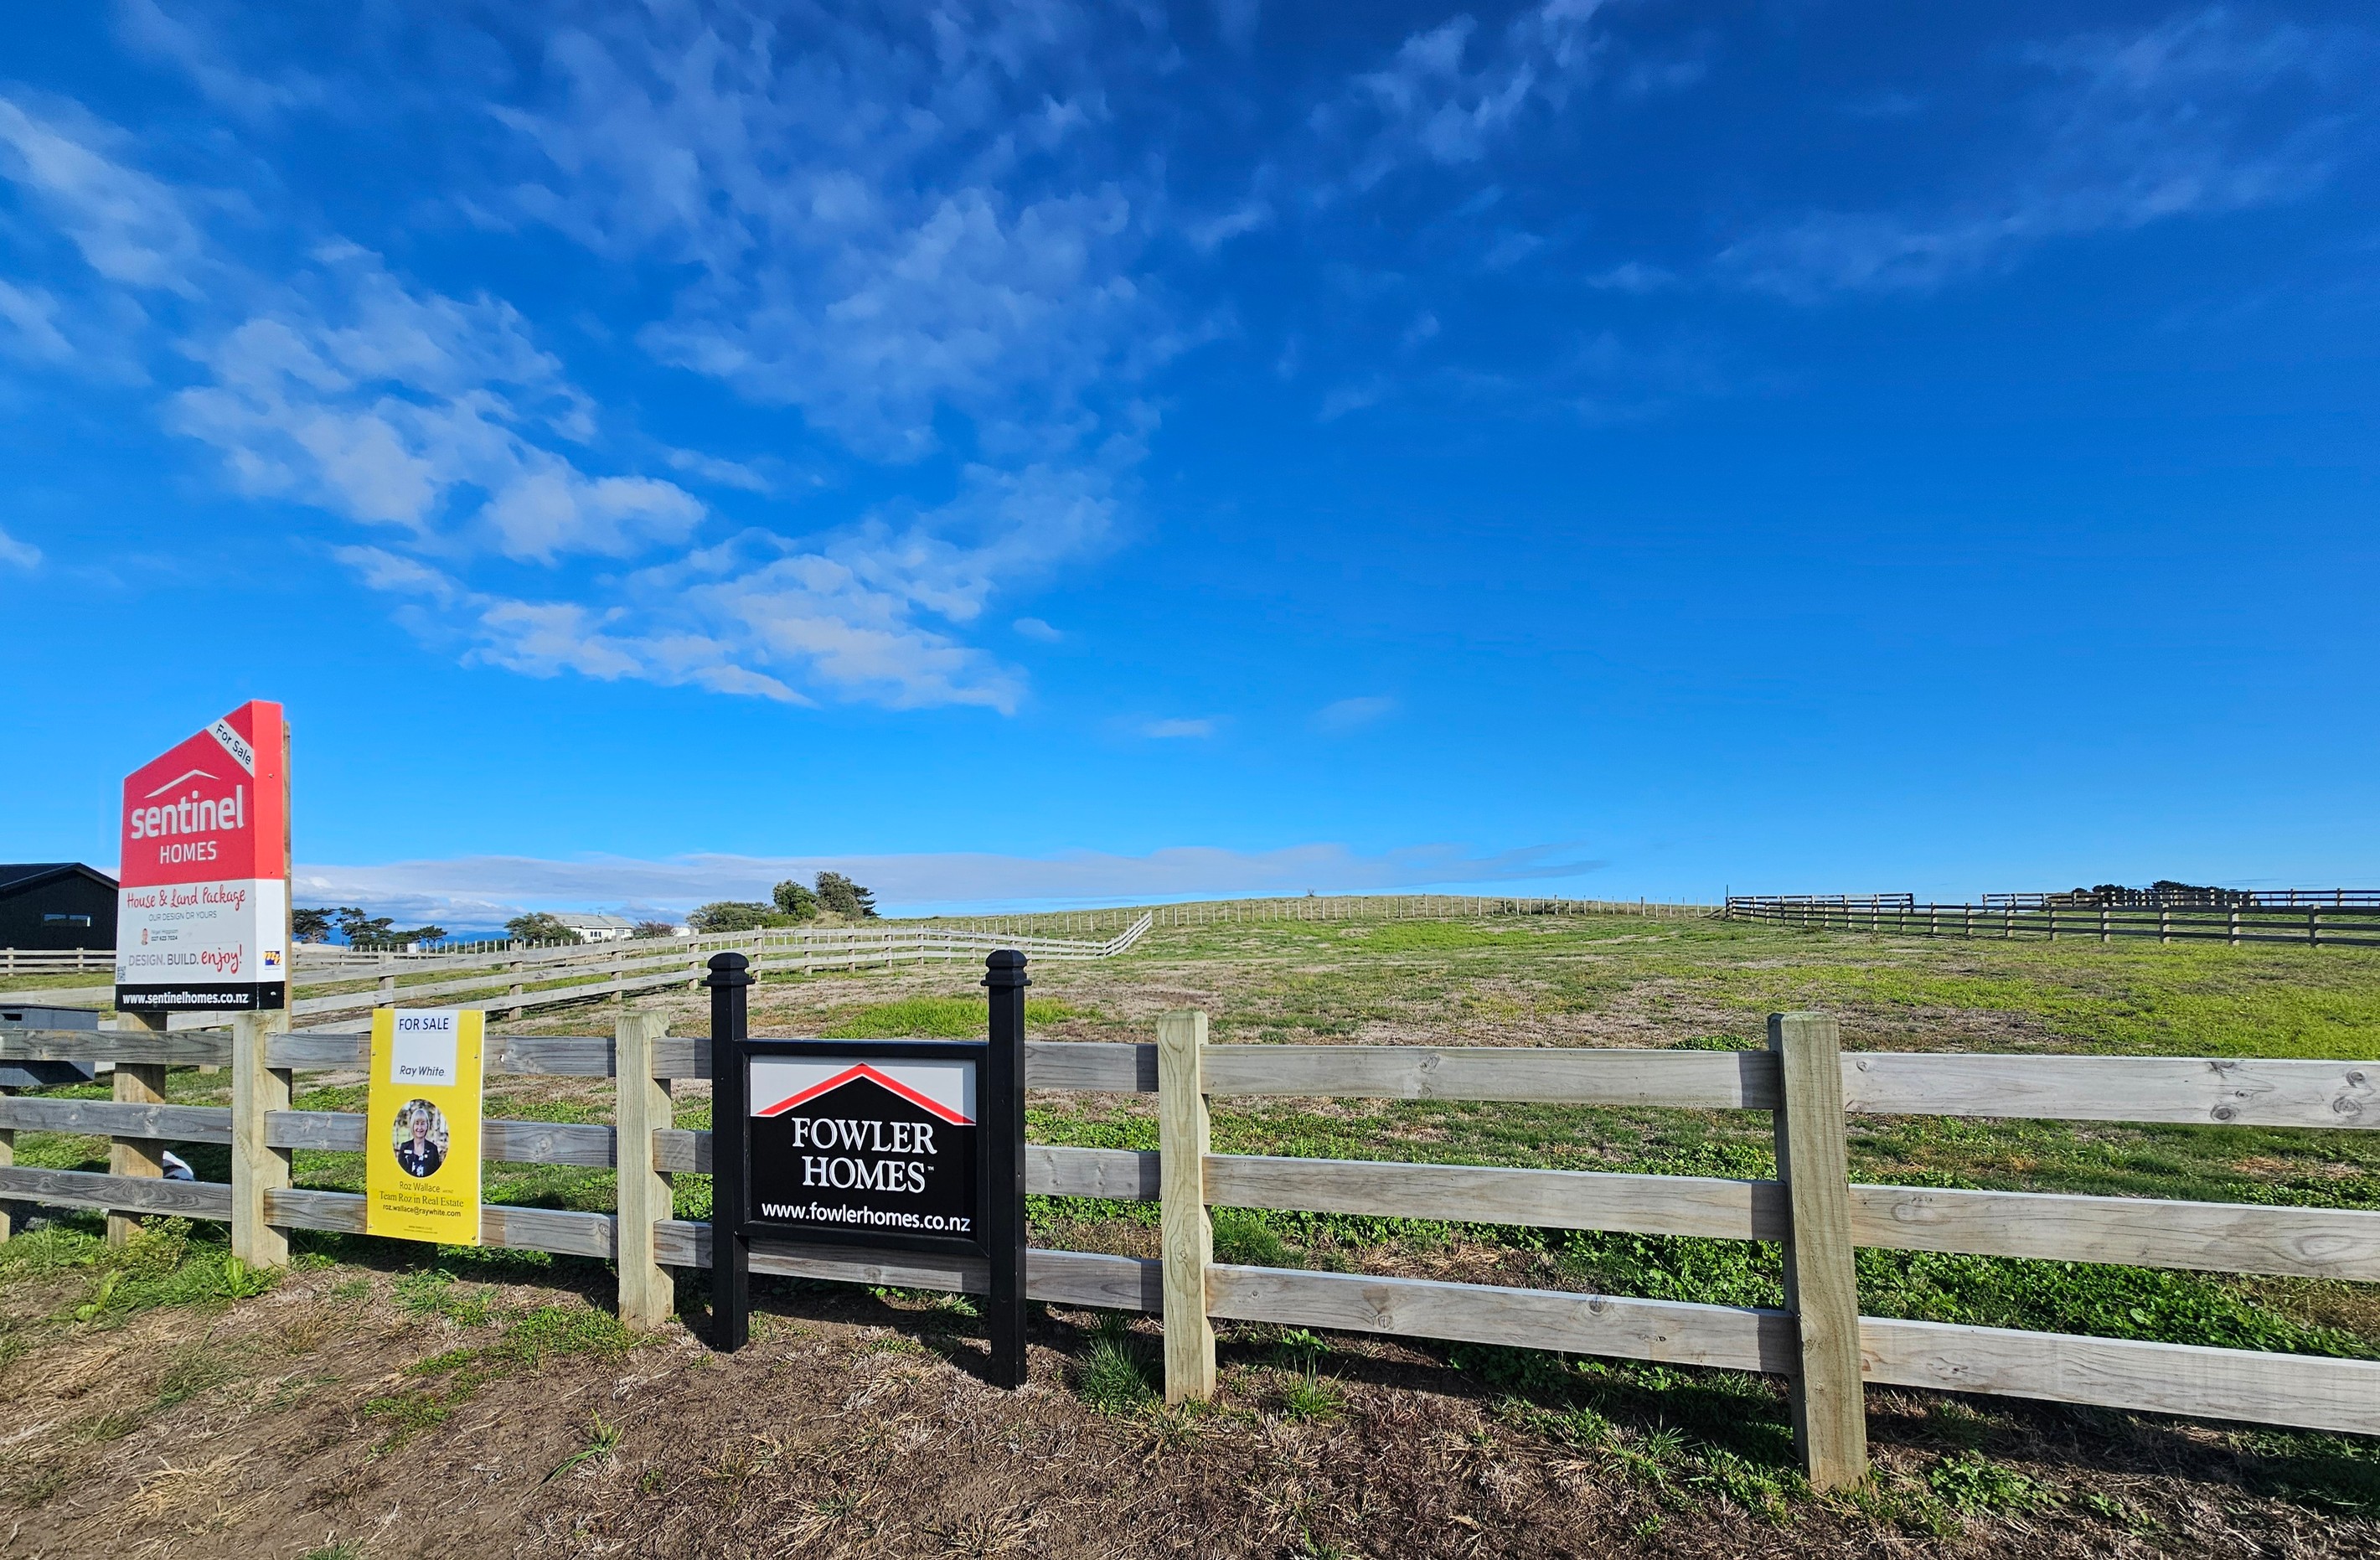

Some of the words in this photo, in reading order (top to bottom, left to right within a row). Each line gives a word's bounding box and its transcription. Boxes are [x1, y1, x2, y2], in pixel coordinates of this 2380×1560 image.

[216, 724, 232, 745] For
[232, 741, 251, 765] Sale
[131, 785, 245, 839] sentinel
[160, 841, 217, 864] HOMES
[127, 892, 156, 909] House
[159, 890, 168, 907] &
[170, 886, 199, 908] Land
[203, 884, 245, 911] Package
[148, 913, 161, 922] OUR
[163, 912, 184, 921] DESIGN
[186, 912, 194, 920] OR
[196, 910, 217, 919] YOURS
[128, 954, 166, 966] DESIGN.
[168, 953, 199, 965] BUILD.
[201, 943, 242, 974] enjoy!
[122, 991, 249, 1005] www.sentinelhomes.co.nz
[399, 1018, 420, 1031] FOR
[422, 1017, 450, 1031] SALE
[400, 1065, 417, 1077] Ray
[419, 1066, 445, 1077] White
[792, 1117, 937, 1155] FOWLER
[802, 1155, 926, 1194] HOMES
[399, 1180, 412, 1191] Roz
[413, 1182, 441, 1193] Wallace
[379, 1191, 397, 1201] Team
[399, 1193, 412, 1202] Roz
[414, 1194, 421, 1203] in
[422, 1196, 438, 1206] Real
[441, 1197, 464, 1207] Estate
[383, 1204, 462, 1217] roz.wallace@raywhite.com
[761, 1201, 971, 1232] www.fowlerhomes.co.nz
